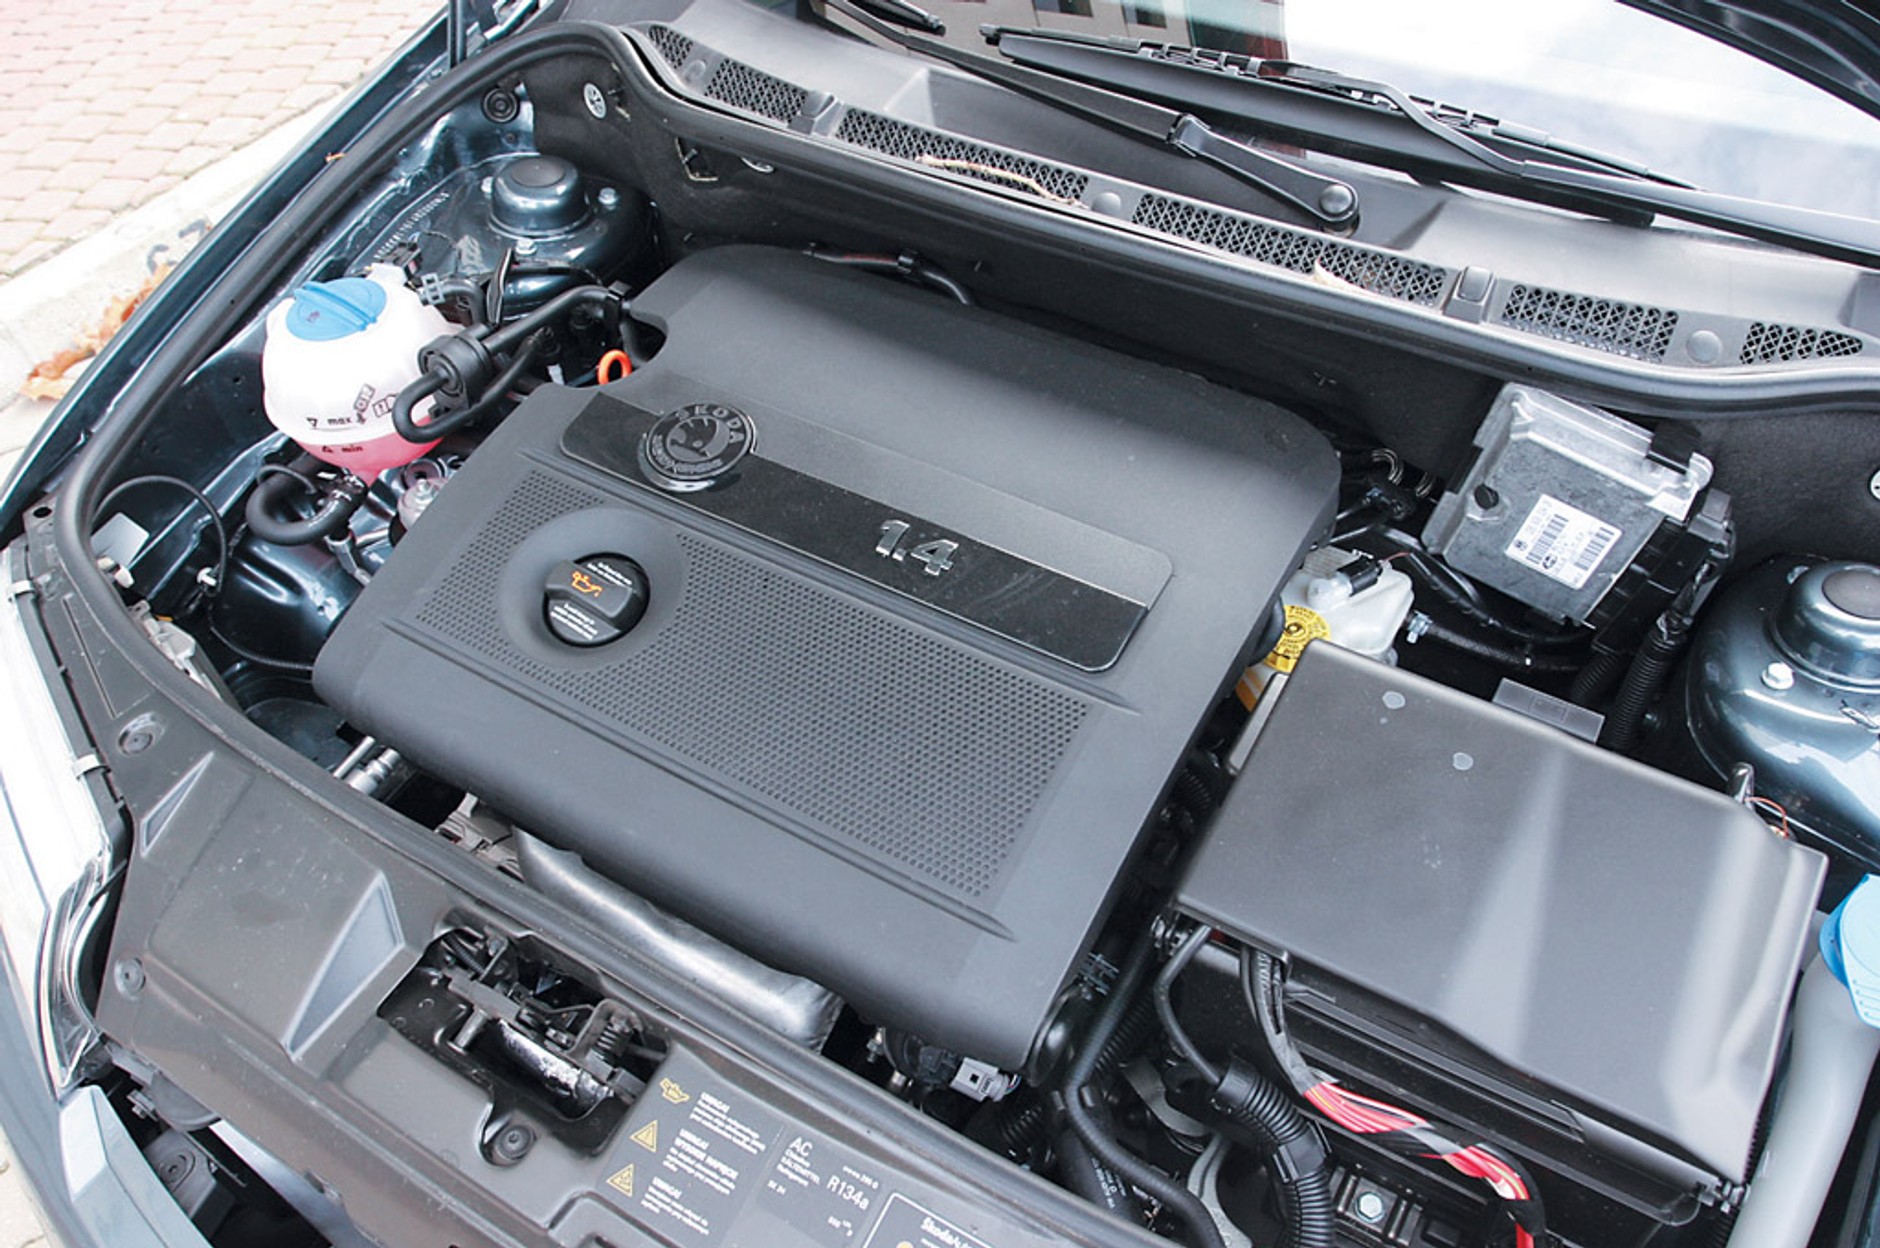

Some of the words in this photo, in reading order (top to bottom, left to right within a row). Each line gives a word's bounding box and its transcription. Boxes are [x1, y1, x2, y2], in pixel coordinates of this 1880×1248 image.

[327, 417, 352, 426] max
[341, 444, 364, 453] min
[876, 520, 959, 576] 1.4
[789, 1137, 813, 1157] AC
[827, 1175, 869, 1210] R134a
